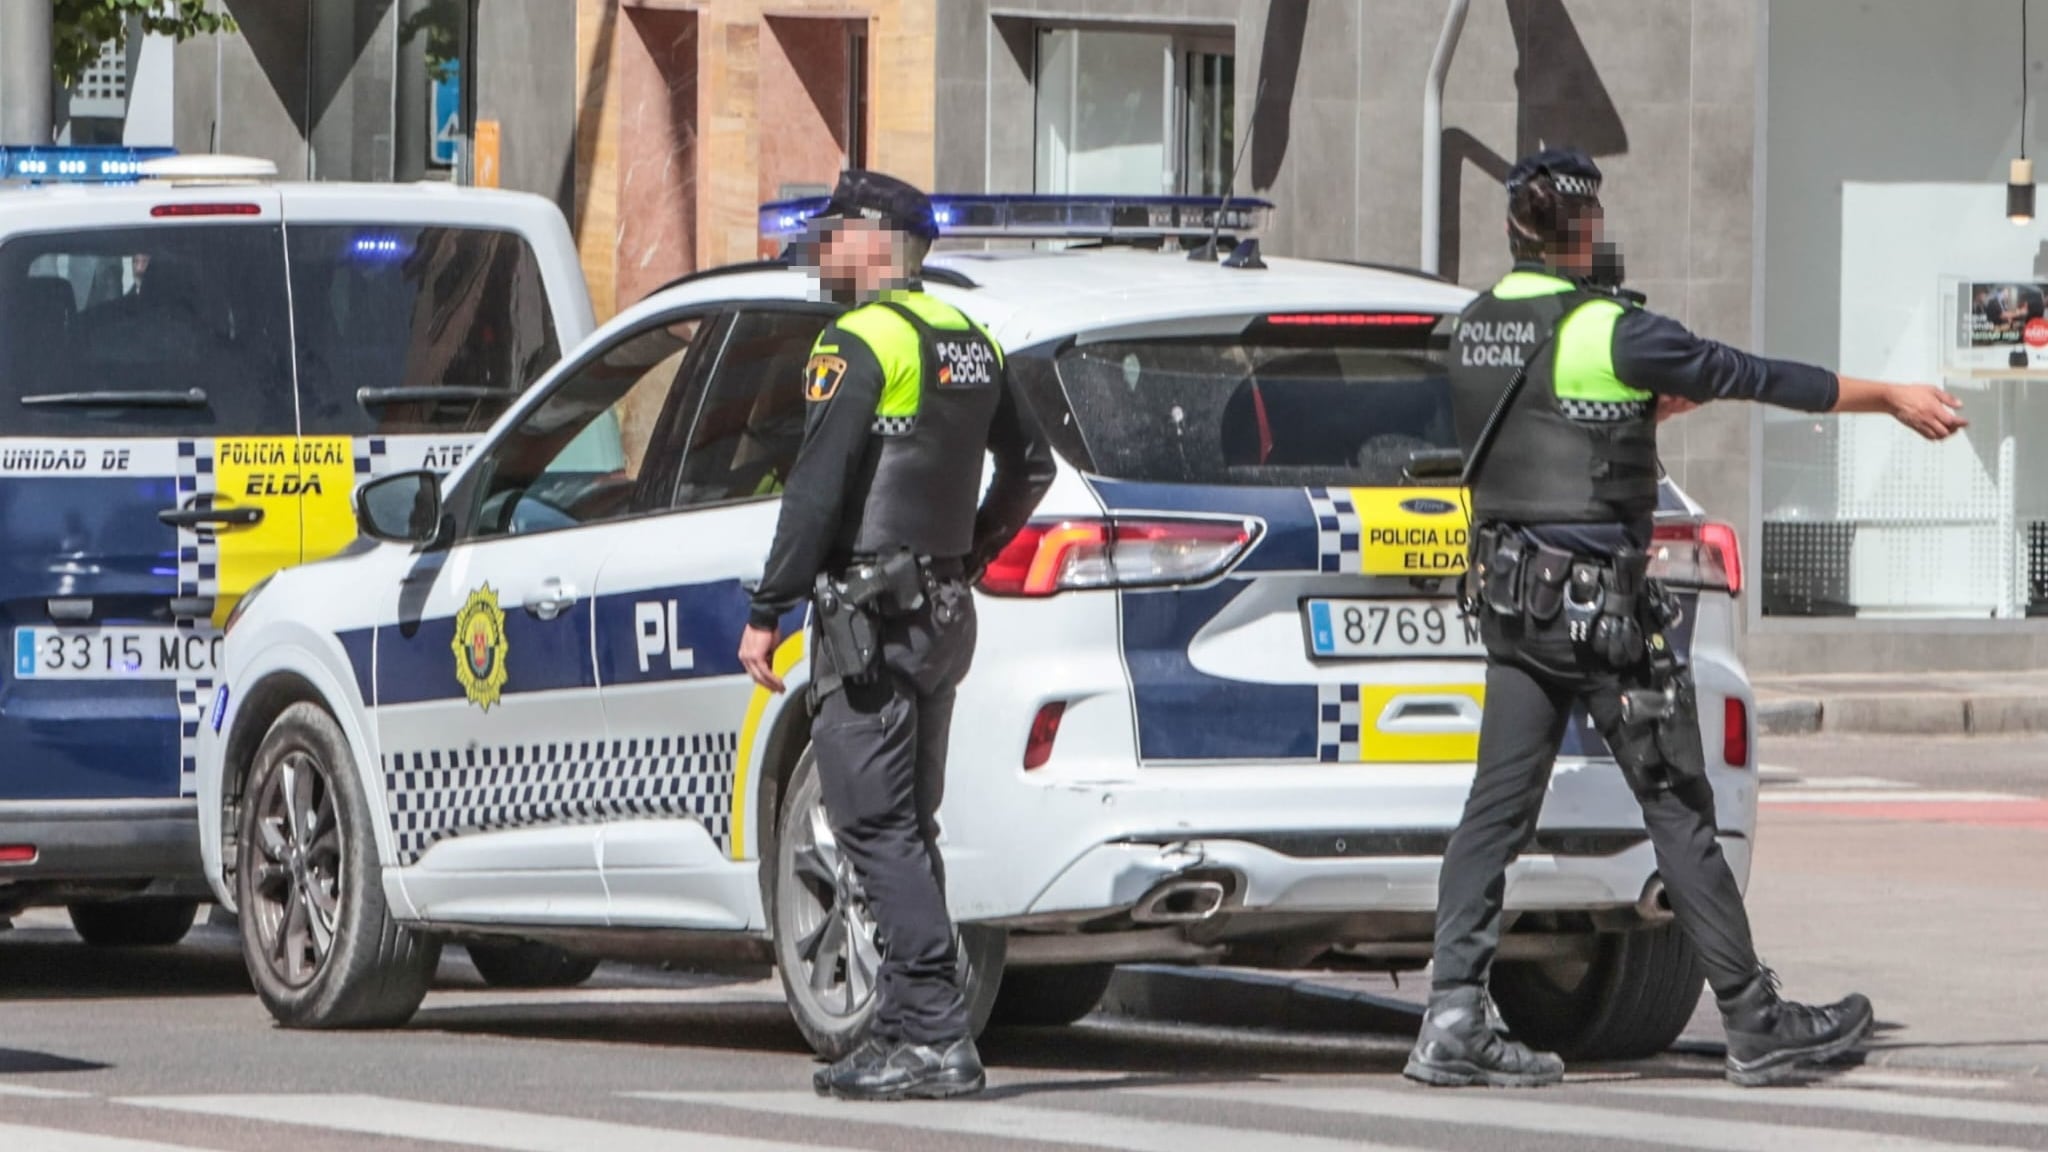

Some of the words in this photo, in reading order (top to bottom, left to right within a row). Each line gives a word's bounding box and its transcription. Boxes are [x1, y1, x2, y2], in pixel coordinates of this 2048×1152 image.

[1459, 321, 1535, 343] POLICIA
[936, 341, 994, 362] POLICIA
[1462, 344, 1525, 367] LOCAL
[949, 361, 991, 383] LOCAL
[3, 449, 86, 470] UNIDAD
[102, 449, 130, 470] DE
[220, 443, 285, 464] POLICIA
[293, 443, 344, 464] LOCAL
[245, 474, 322, 495] ELDA
[1370, 528, 1439, 545] POLICIA
[1445, 528, 1467, 545] LO
[1404, 552, 1467, 569] ELDA
[635, 598, 694, 672] PL
[1343, 606, 1446, 645] 8769
[1463, 611, 1482, 646] M
[45, 635, 143, 670] 3315
